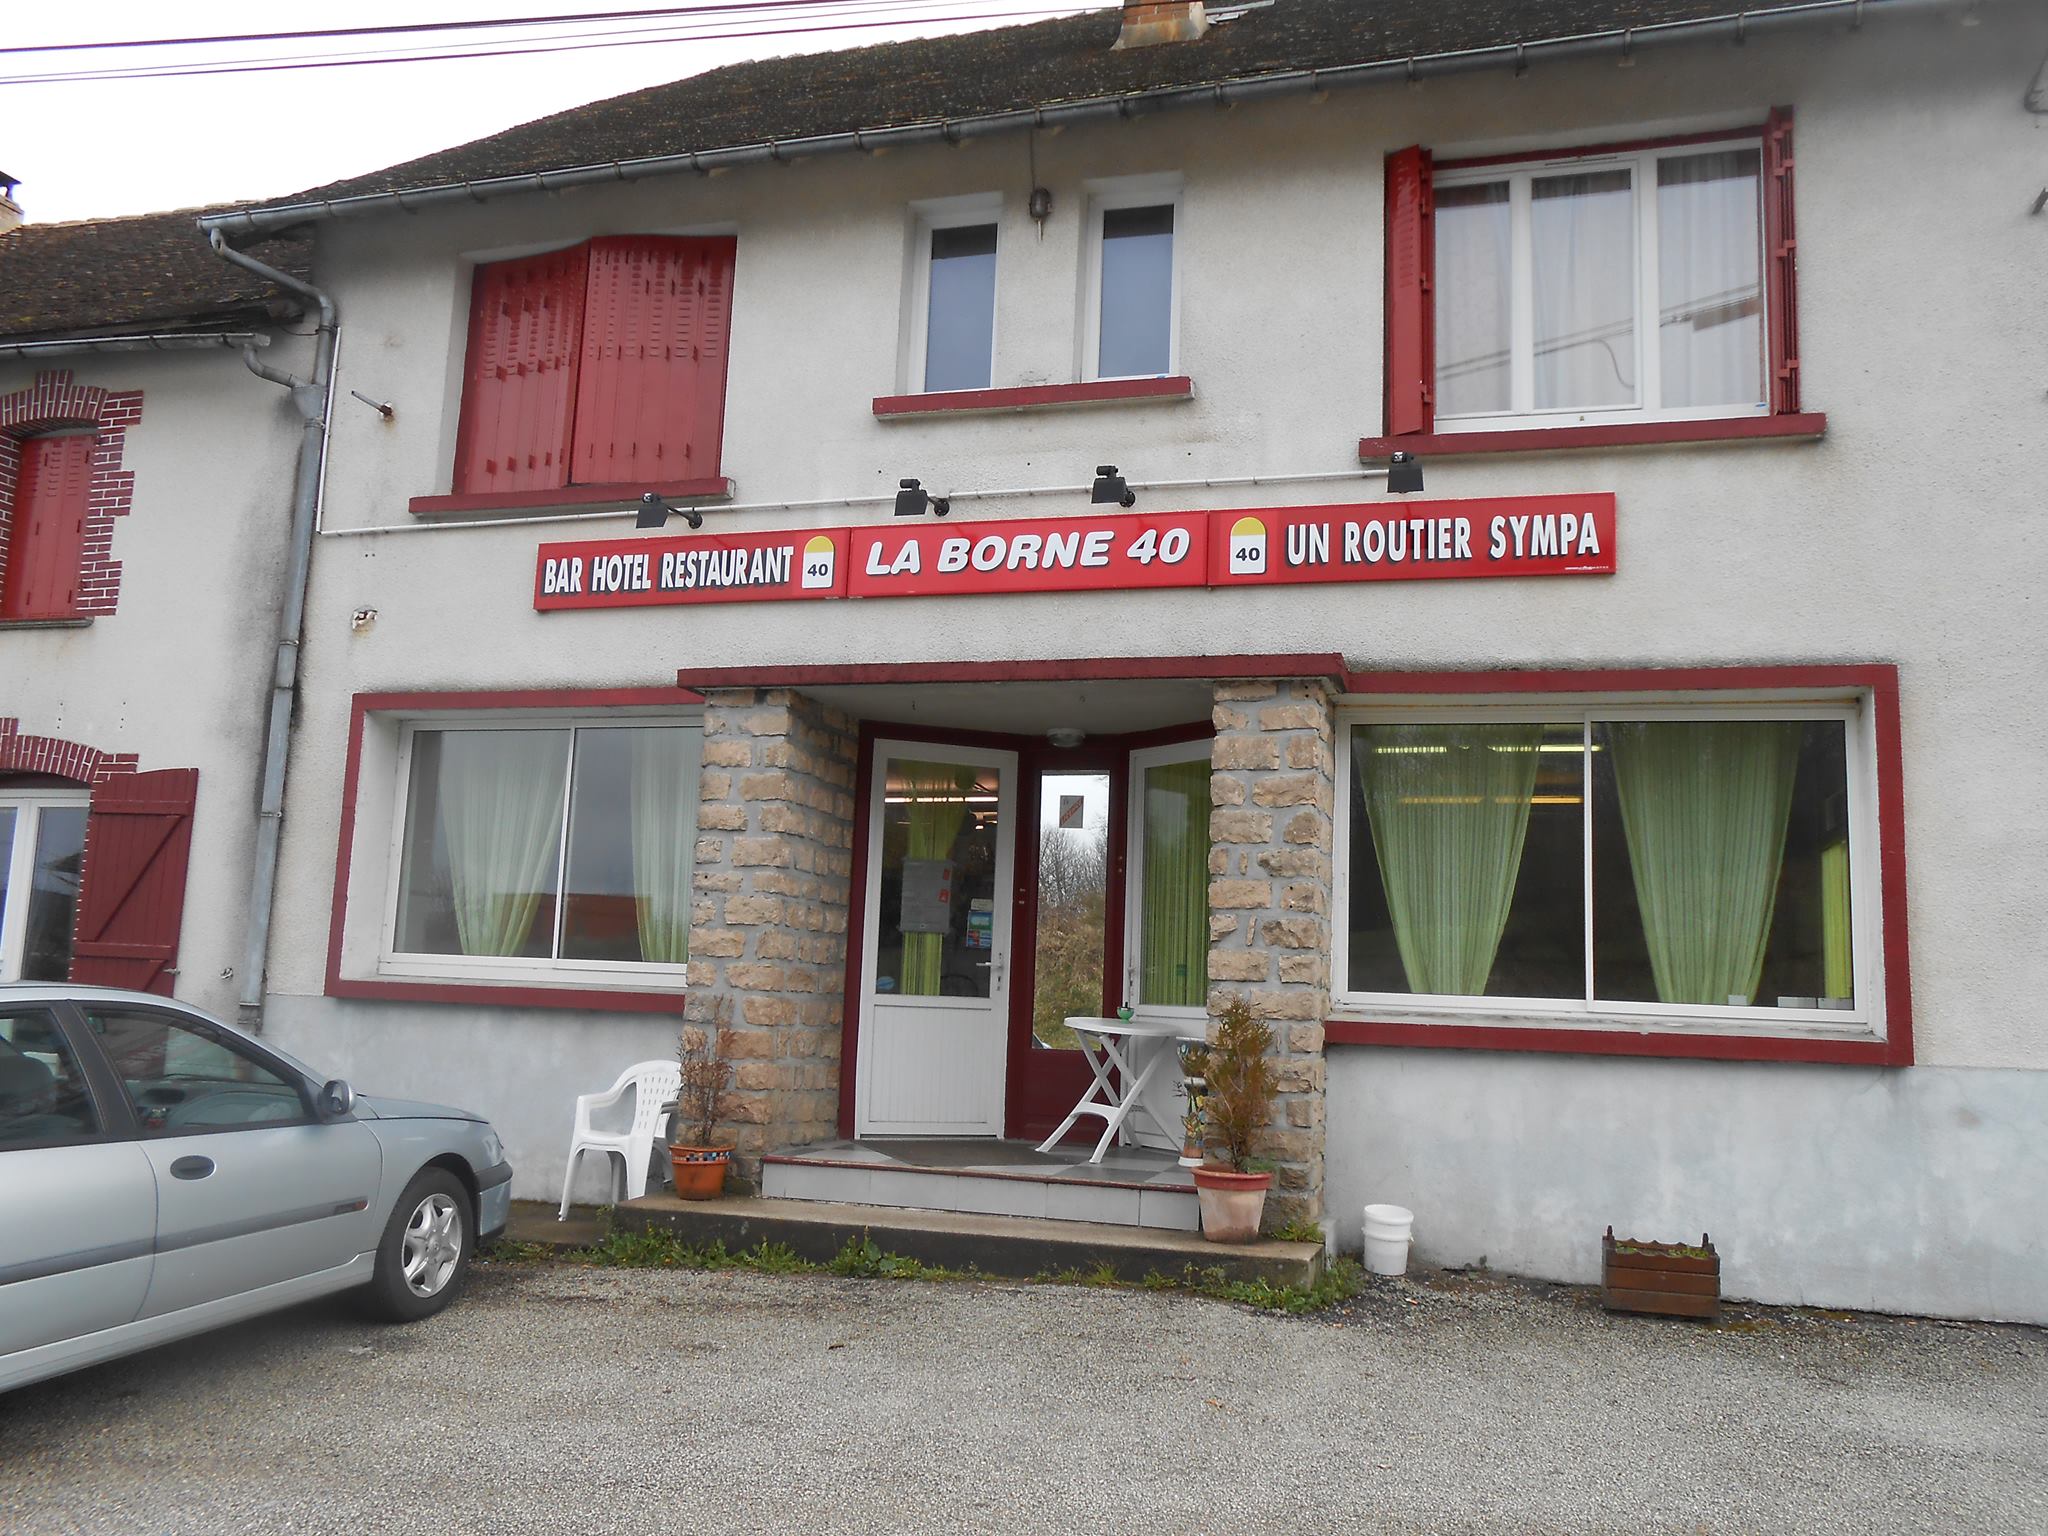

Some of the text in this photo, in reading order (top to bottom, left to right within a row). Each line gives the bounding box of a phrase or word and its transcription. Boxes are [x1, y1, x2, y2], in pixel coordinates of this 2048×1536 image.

[865, 527, 1190, 575] LA BORNE 40
[1235, 547, 1261, 562] 40
[1287, 512, 1600, 565] UN ROUTIER SYMPA
[544, 546, 794, 594] BAR HOTEL RESTAURANT
[807, 563, 829, 577] 40
